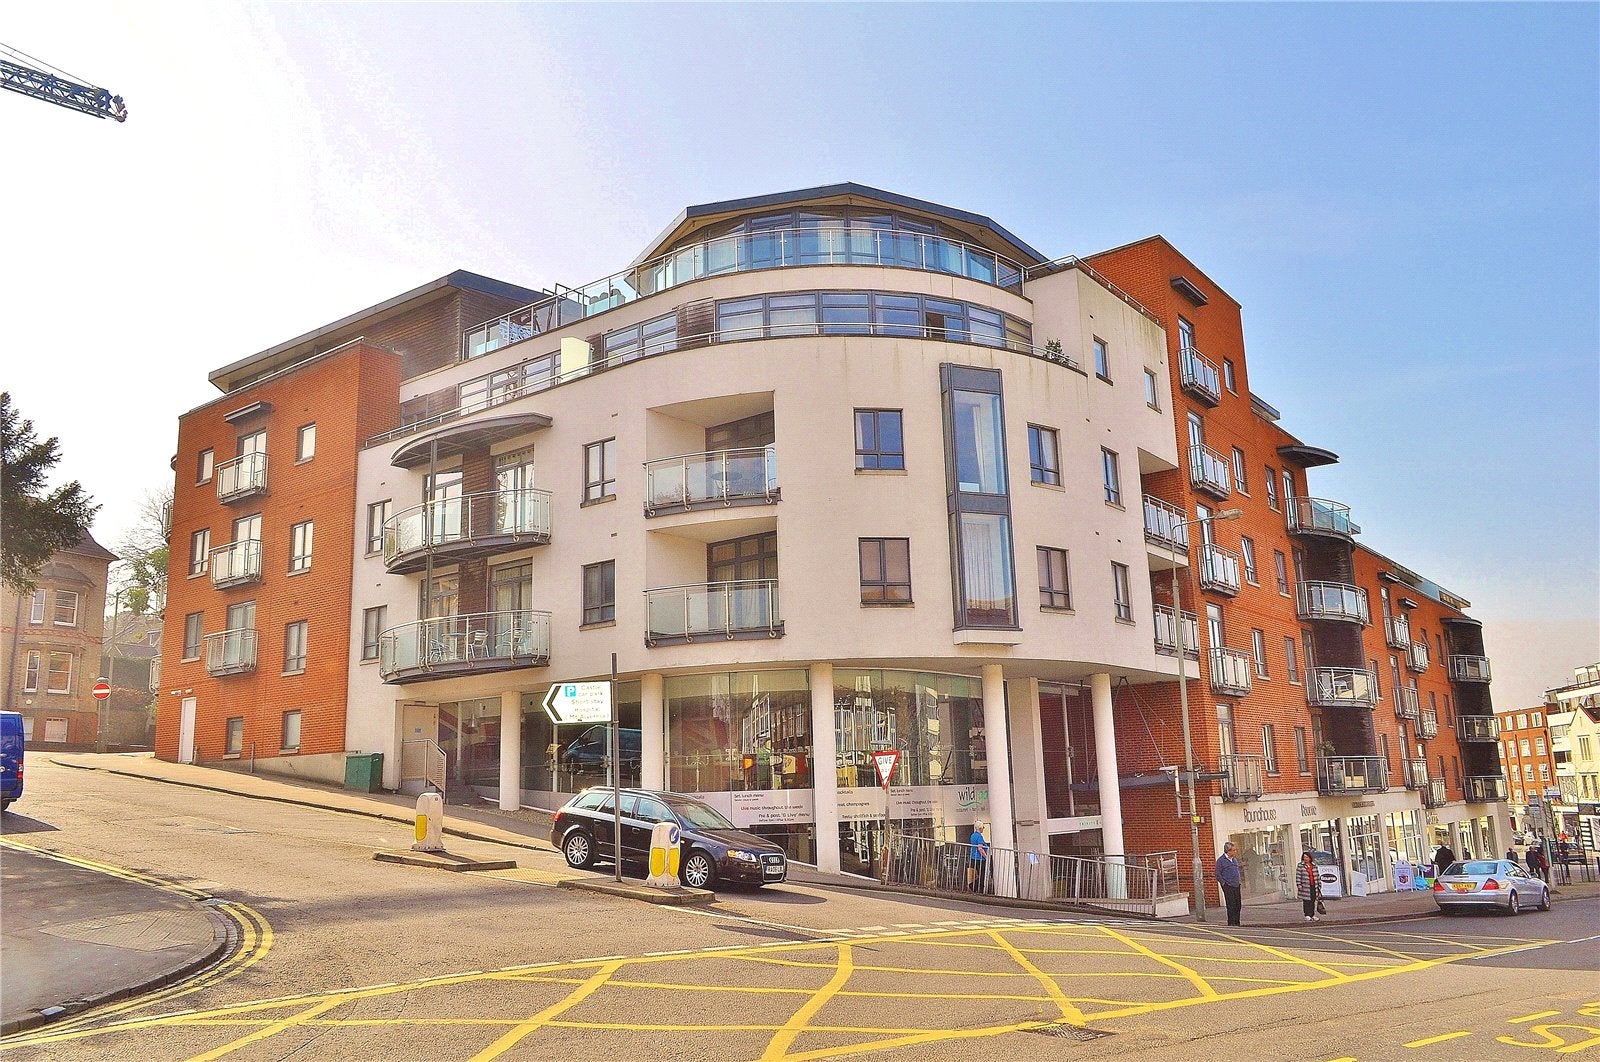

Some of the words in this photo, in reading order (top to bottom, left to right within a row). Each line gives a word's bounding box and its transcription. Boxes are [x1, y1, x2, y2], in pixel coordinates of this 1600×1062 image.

[878, 756, 892, 765] GIVE
[958, 786, 975, 801] wild
[1243, 807, 1277, 822] Roundhouse
